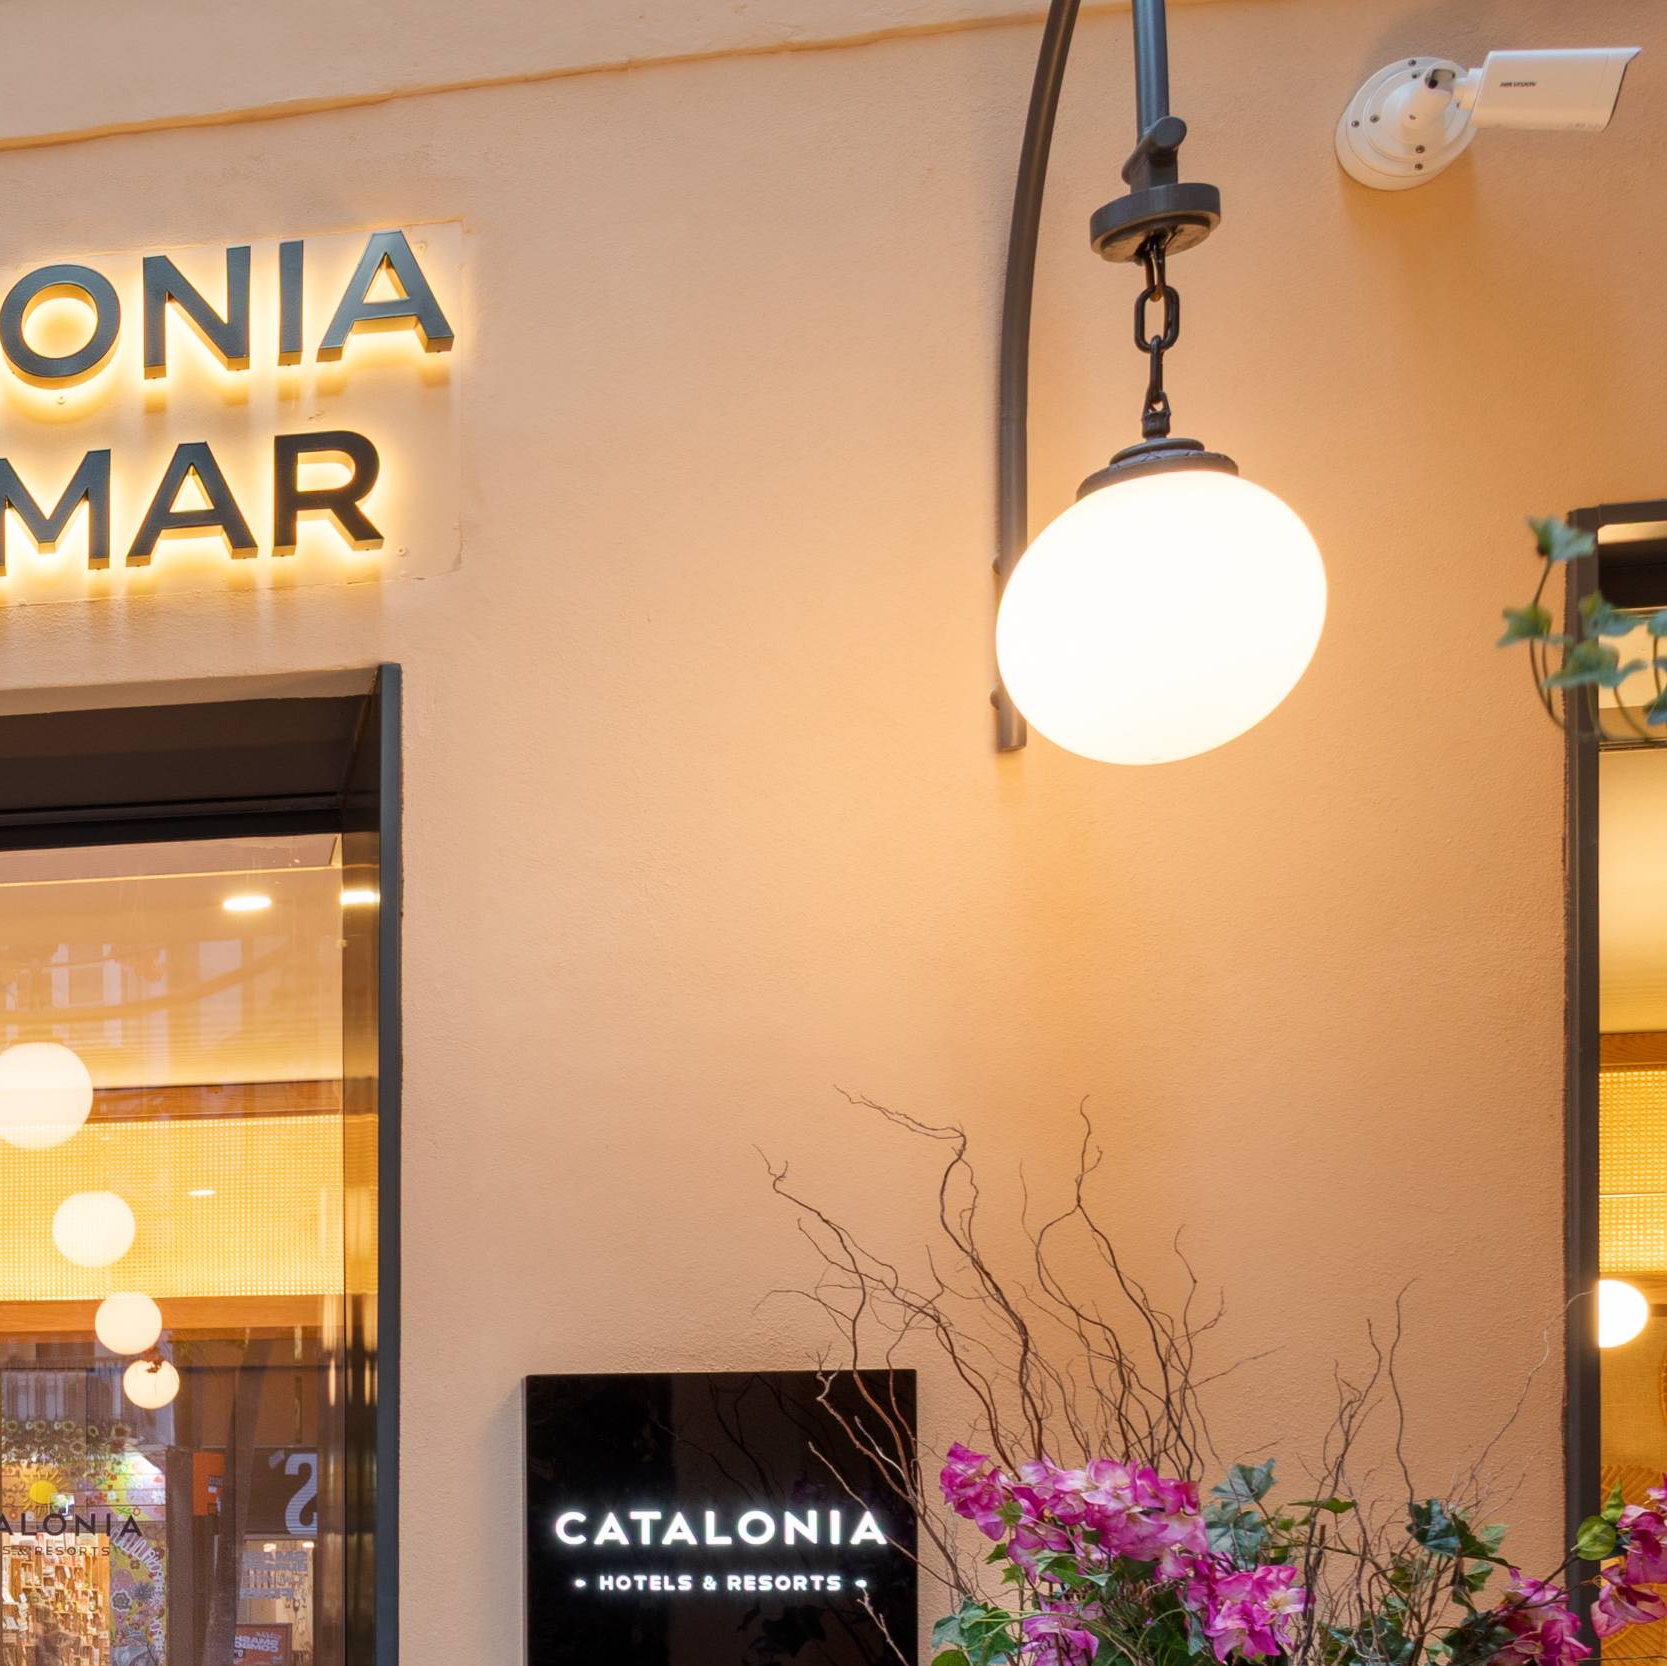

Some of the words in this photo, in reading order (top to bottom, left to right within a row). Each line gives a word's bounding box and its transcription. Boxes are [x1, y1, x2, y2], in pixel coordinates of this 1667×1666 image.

[554, 1508, 888, 1546] CATALONIA
[35, 1545, 110, 1556] RESORTS
[598, 1574, 693, 1593] HOTELS
[702, 1574, 717, 1592] &
[726, 1574, 843, 1593] RESORTS
